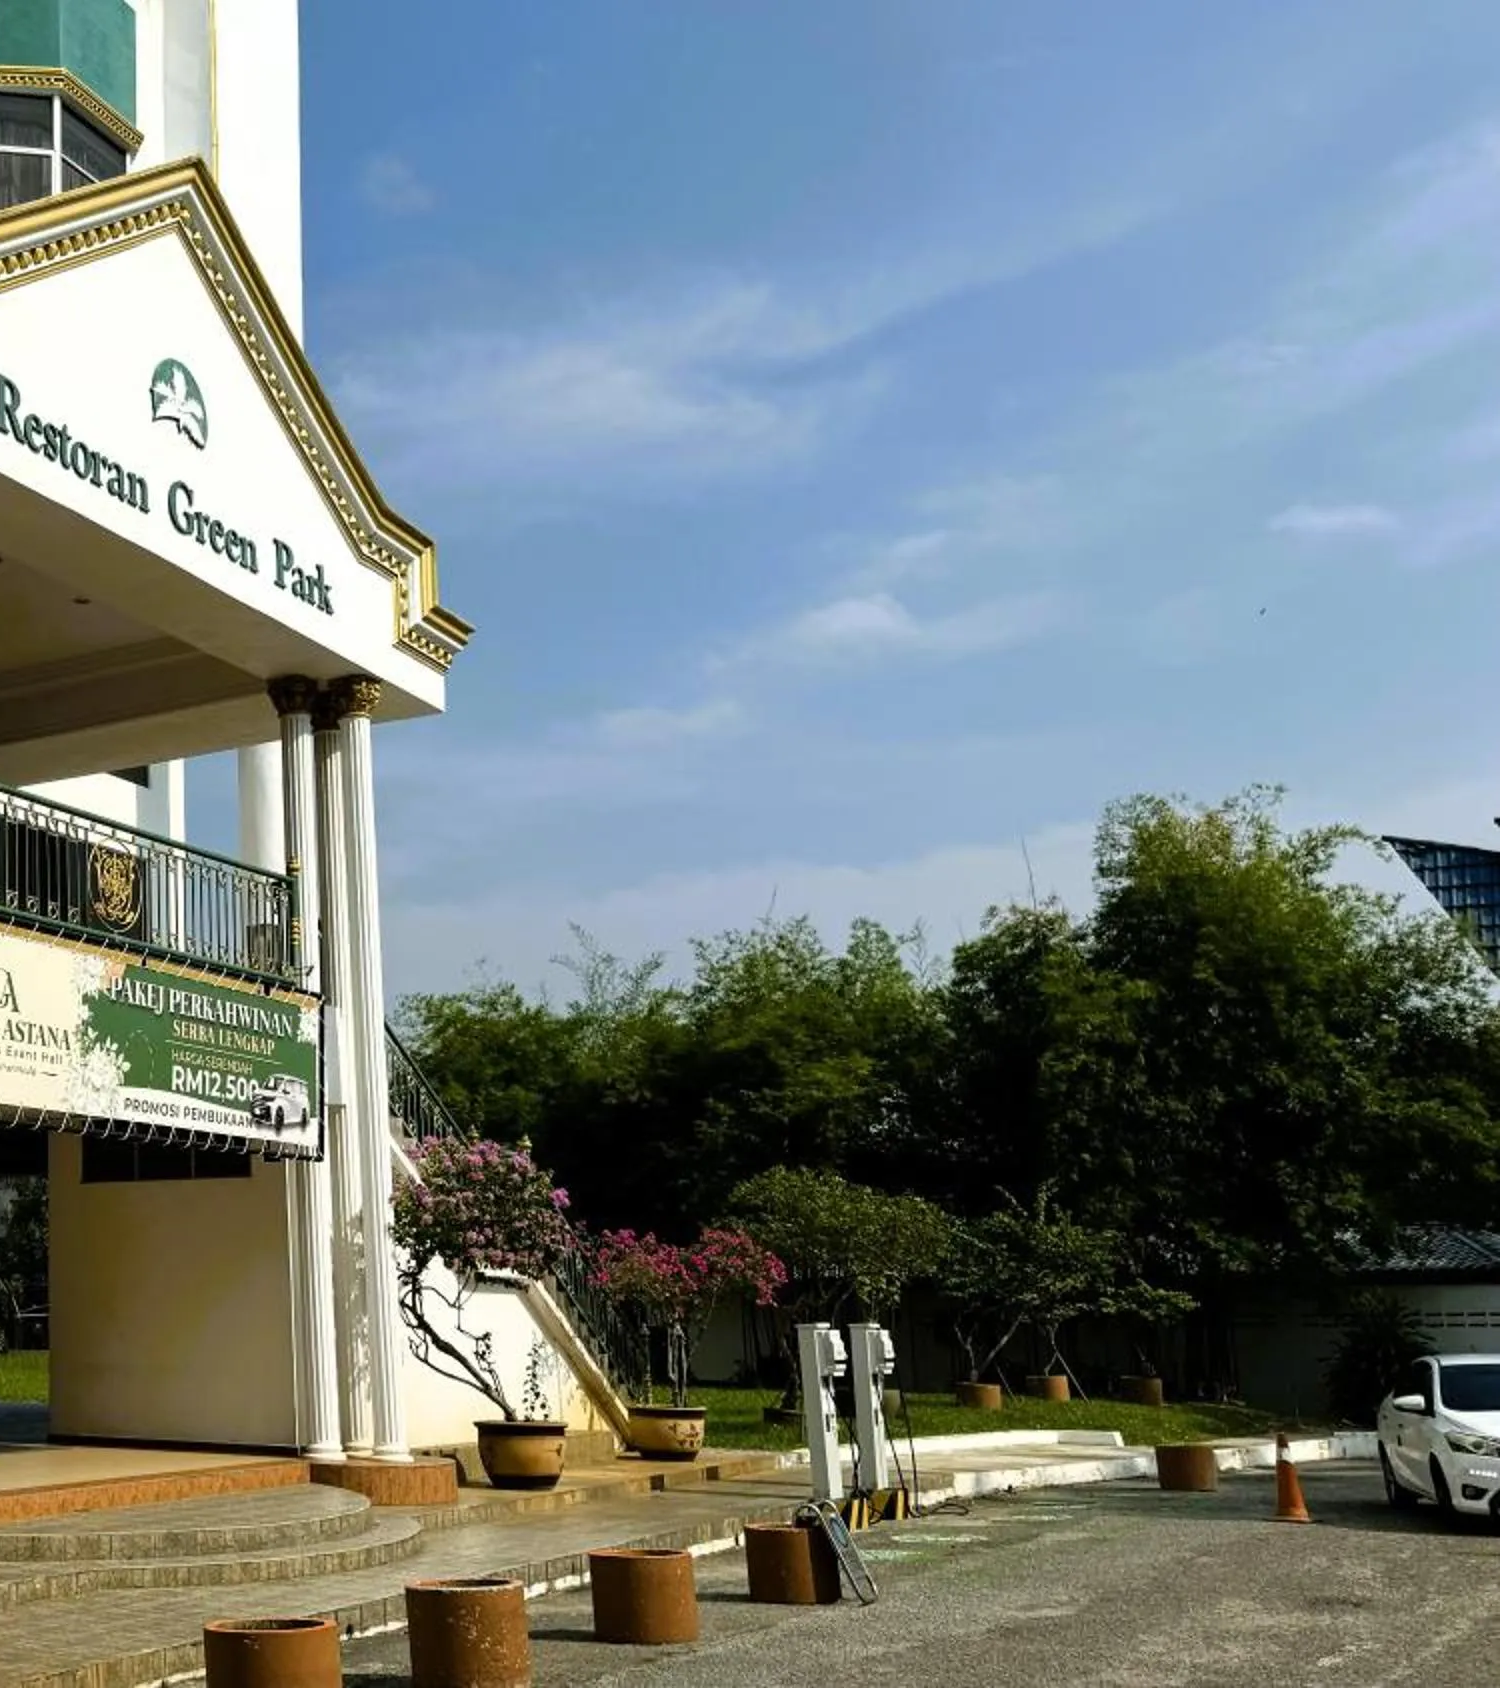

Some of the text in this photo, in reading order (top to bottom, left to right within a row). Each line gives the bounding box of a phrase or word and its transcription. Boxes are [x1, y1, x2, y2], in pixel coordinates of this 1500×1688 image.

[167, 480, 259, 574] Green
[272, 537, 334, 615] Park
[111, 976, 293, 1039] PAKEJ PERKAHWINAN
[2, 1018, 71, 1051] ASTANA
[173, 1019, 275, 1056] SERBA LENGKAP
[124, 1097, 255, 1129] PROMOSI PEMBUKAAN
